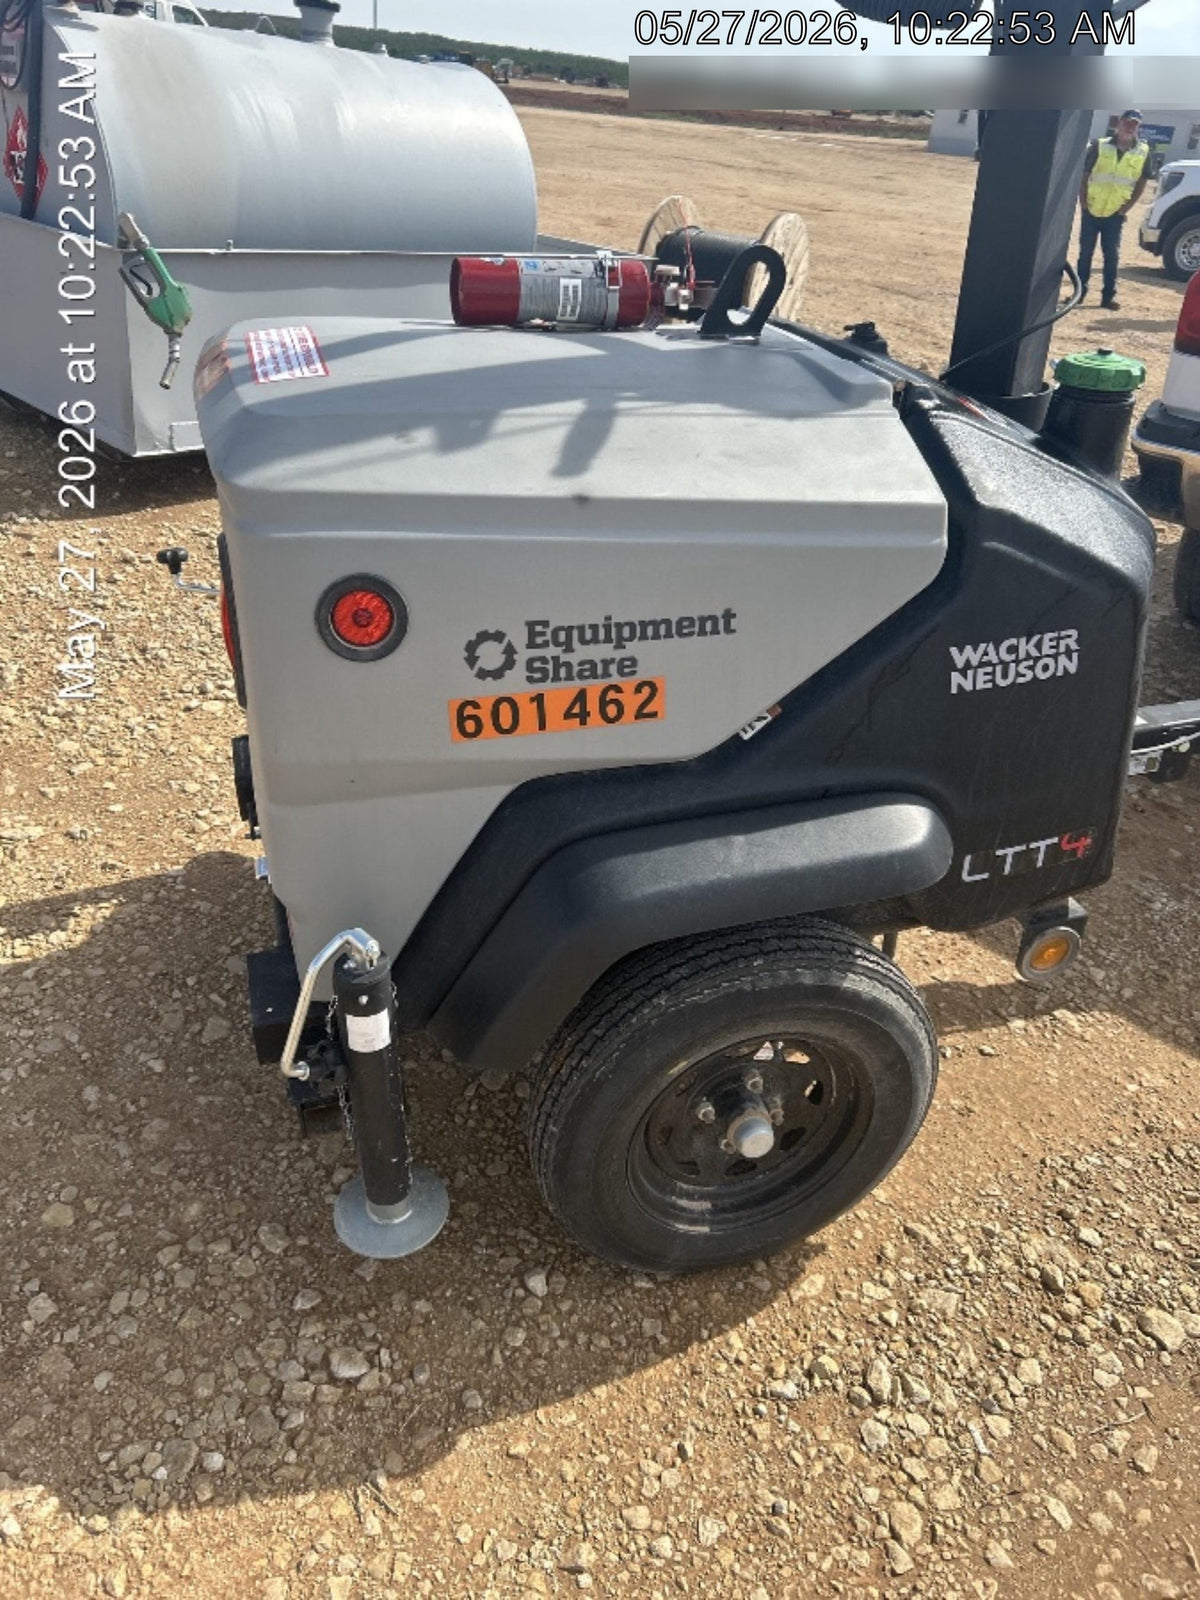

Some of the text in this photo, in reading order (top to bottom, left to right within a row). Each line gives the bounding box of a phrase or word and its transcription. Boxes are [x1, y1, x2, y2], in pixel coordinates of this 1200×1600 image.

[524, 607, 738, 653] Equipment
[949, 628, 1081, 670] WACKER
[524, 655, 639, 684] Share
[950, 652, 1079, 695] NEUSON
[455, 679, 660, 739] 601462
